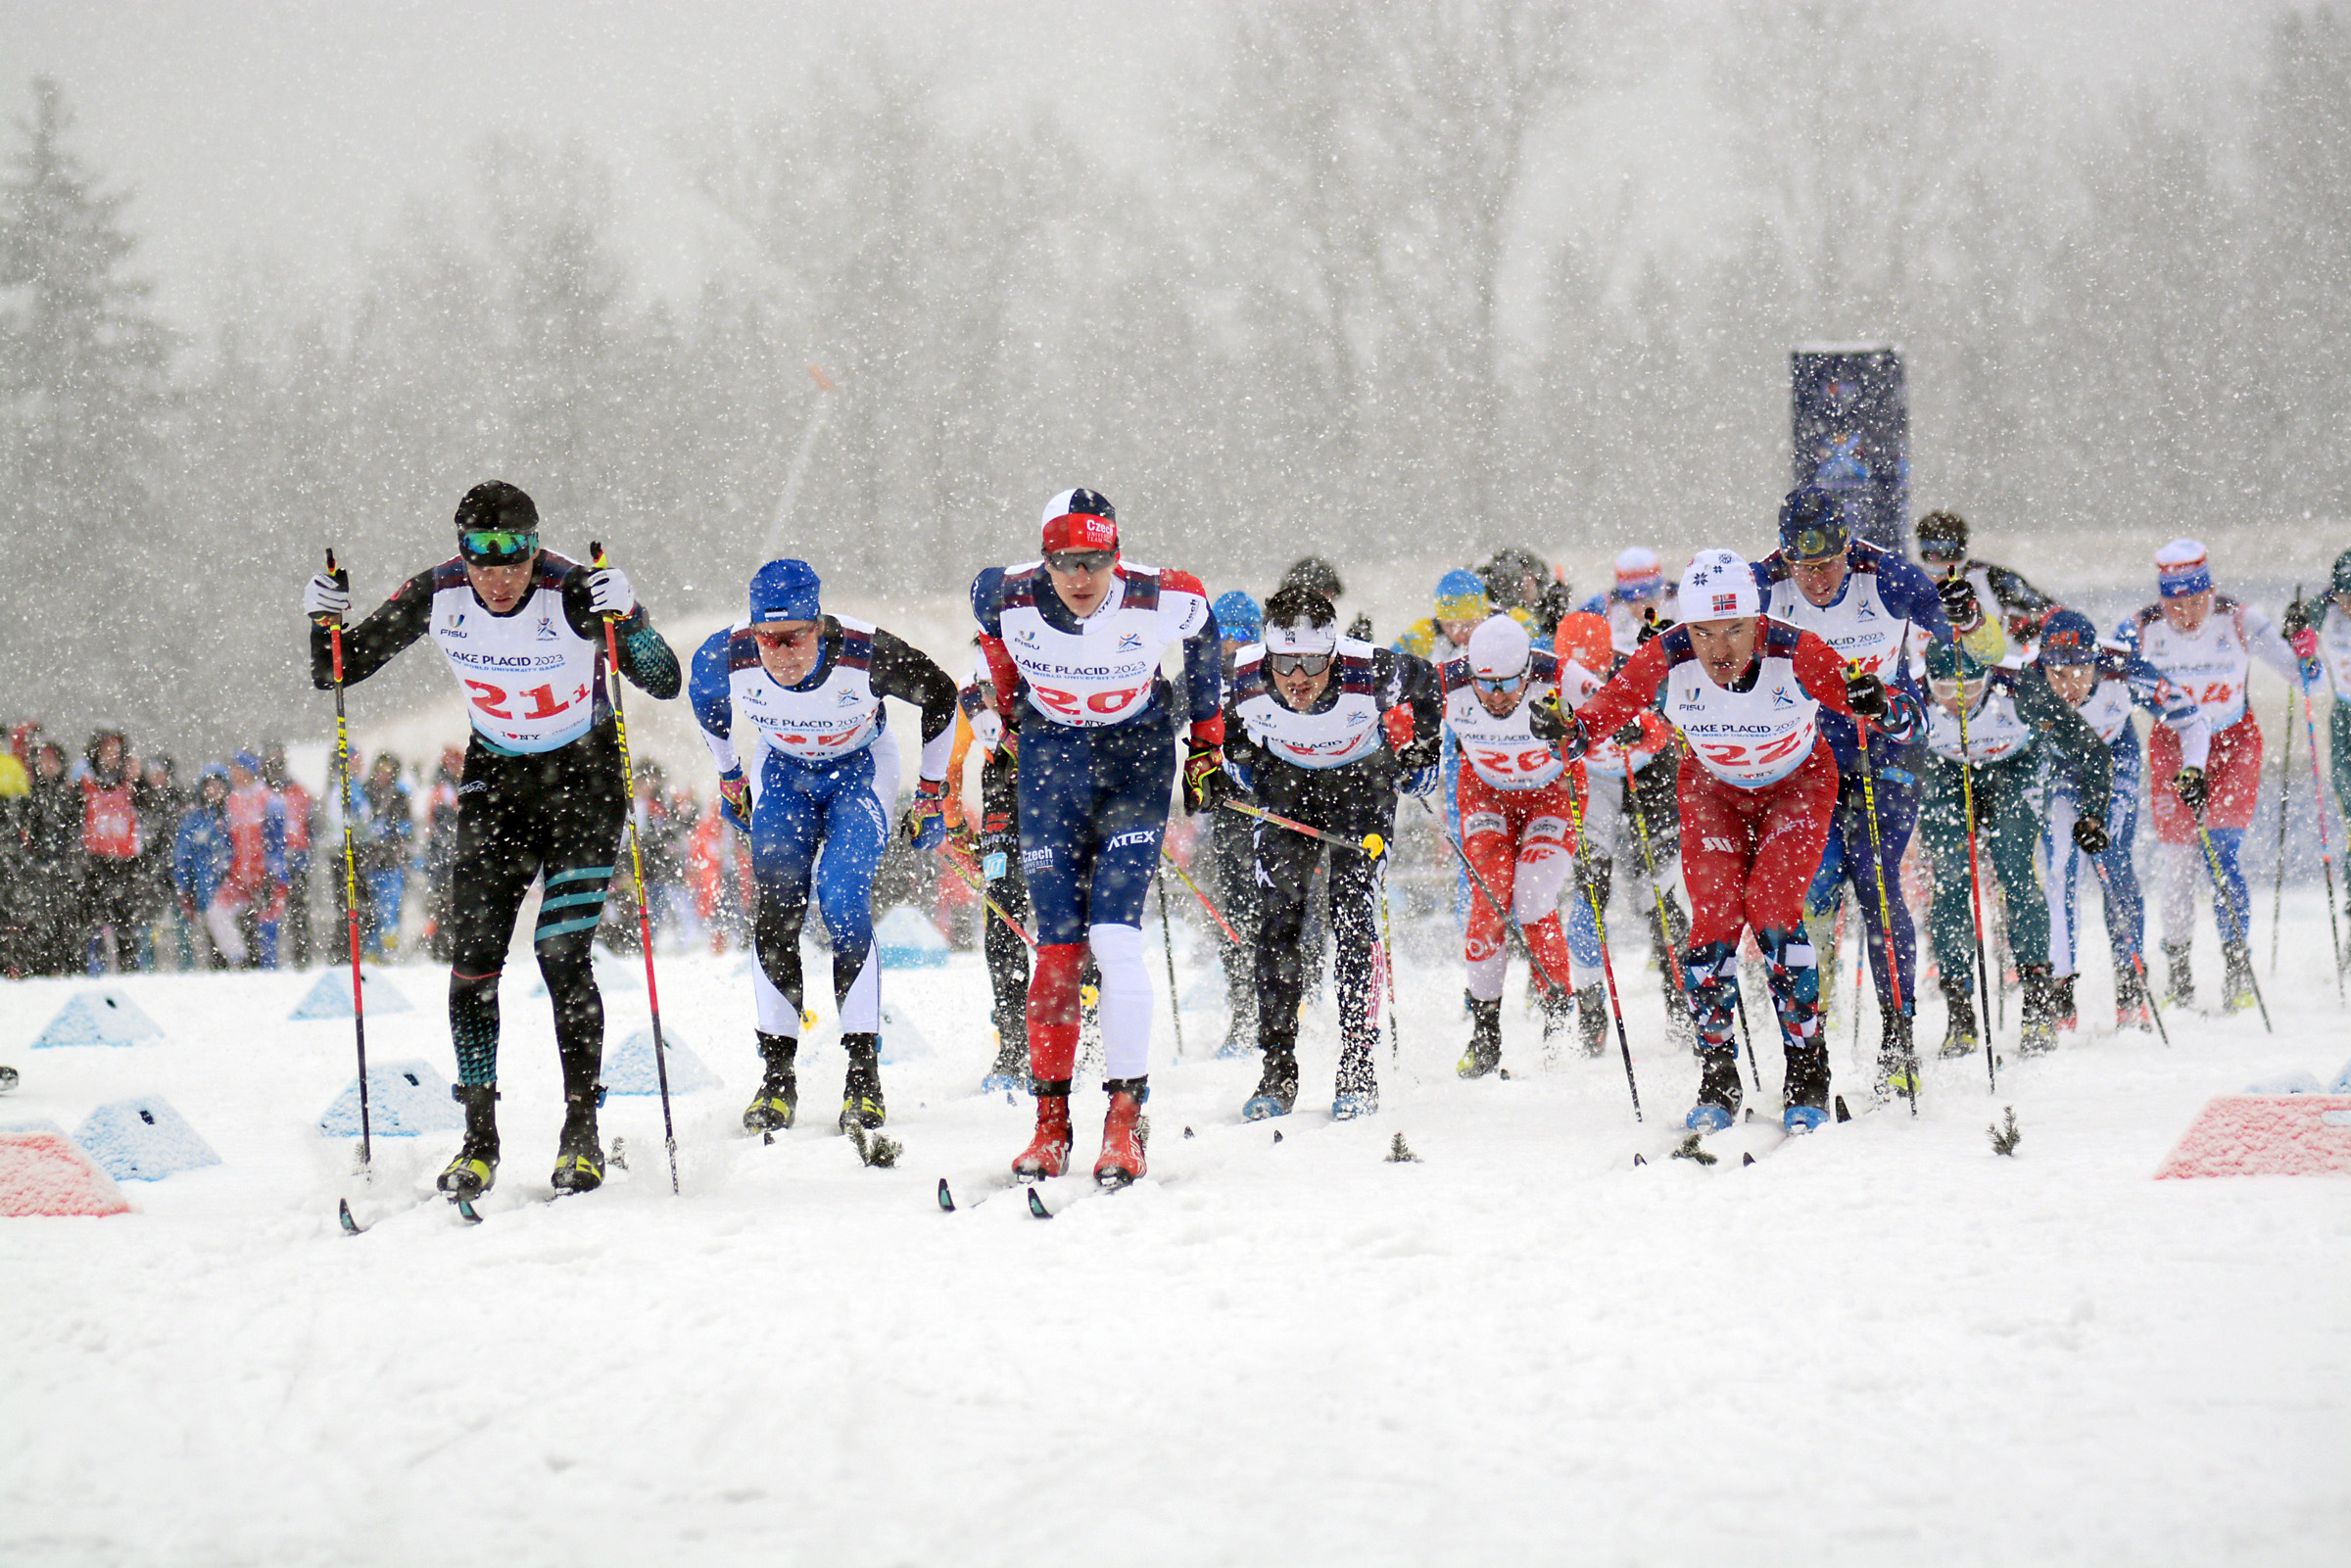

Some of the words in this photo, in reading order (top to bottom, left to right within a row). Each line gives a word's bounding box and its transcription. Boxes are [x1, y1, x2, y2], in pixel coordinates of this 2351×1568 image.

[1086, 519, 1114, 536] Czech
[440, 628, 468, 639] FISU
[1826, 637, 1856, 646] ACID
[1857, 632, 1885, 643] 2023
[1014, 638, 1040, 650] FISU
[445, 647, 479, 664] LAKE
[482, 655, 531, 667] PLACID
[534, 653, 564, 666] 2023
[1015, 654, 1051, 673] LAKE
[1055, 666, 1110, 676] PLACID
[1113, 661, 1146, 675] 2023
[464, 679, 570, 721] 21
[573, 683, 591, 704] 1
[743, 695, 767, 706] FISU
[1031, 683, 1138, 716] 20
[1679, 703, 1705, 712] FISU
[614, 710, 628, 753] LEKI
[782, 719, 833, 728] PLACID
[1683, 724, 1718, 733] LAKE
[1721, 725, 1771, 734] PLACID
[337, 715, 349, 758] LEKI
[1700, 731, 1801, 767] 22
[1474, 747, 1553, 774] 26
[1863, 777, 1875, 811] LEKI
[1569, 800, 1584, 832] LEKI
[1758, 819, 1806, 852] CRAFT
[1022, 845, 1053, 864] Czech
[1024, 867, 1036, 876] TEAM
